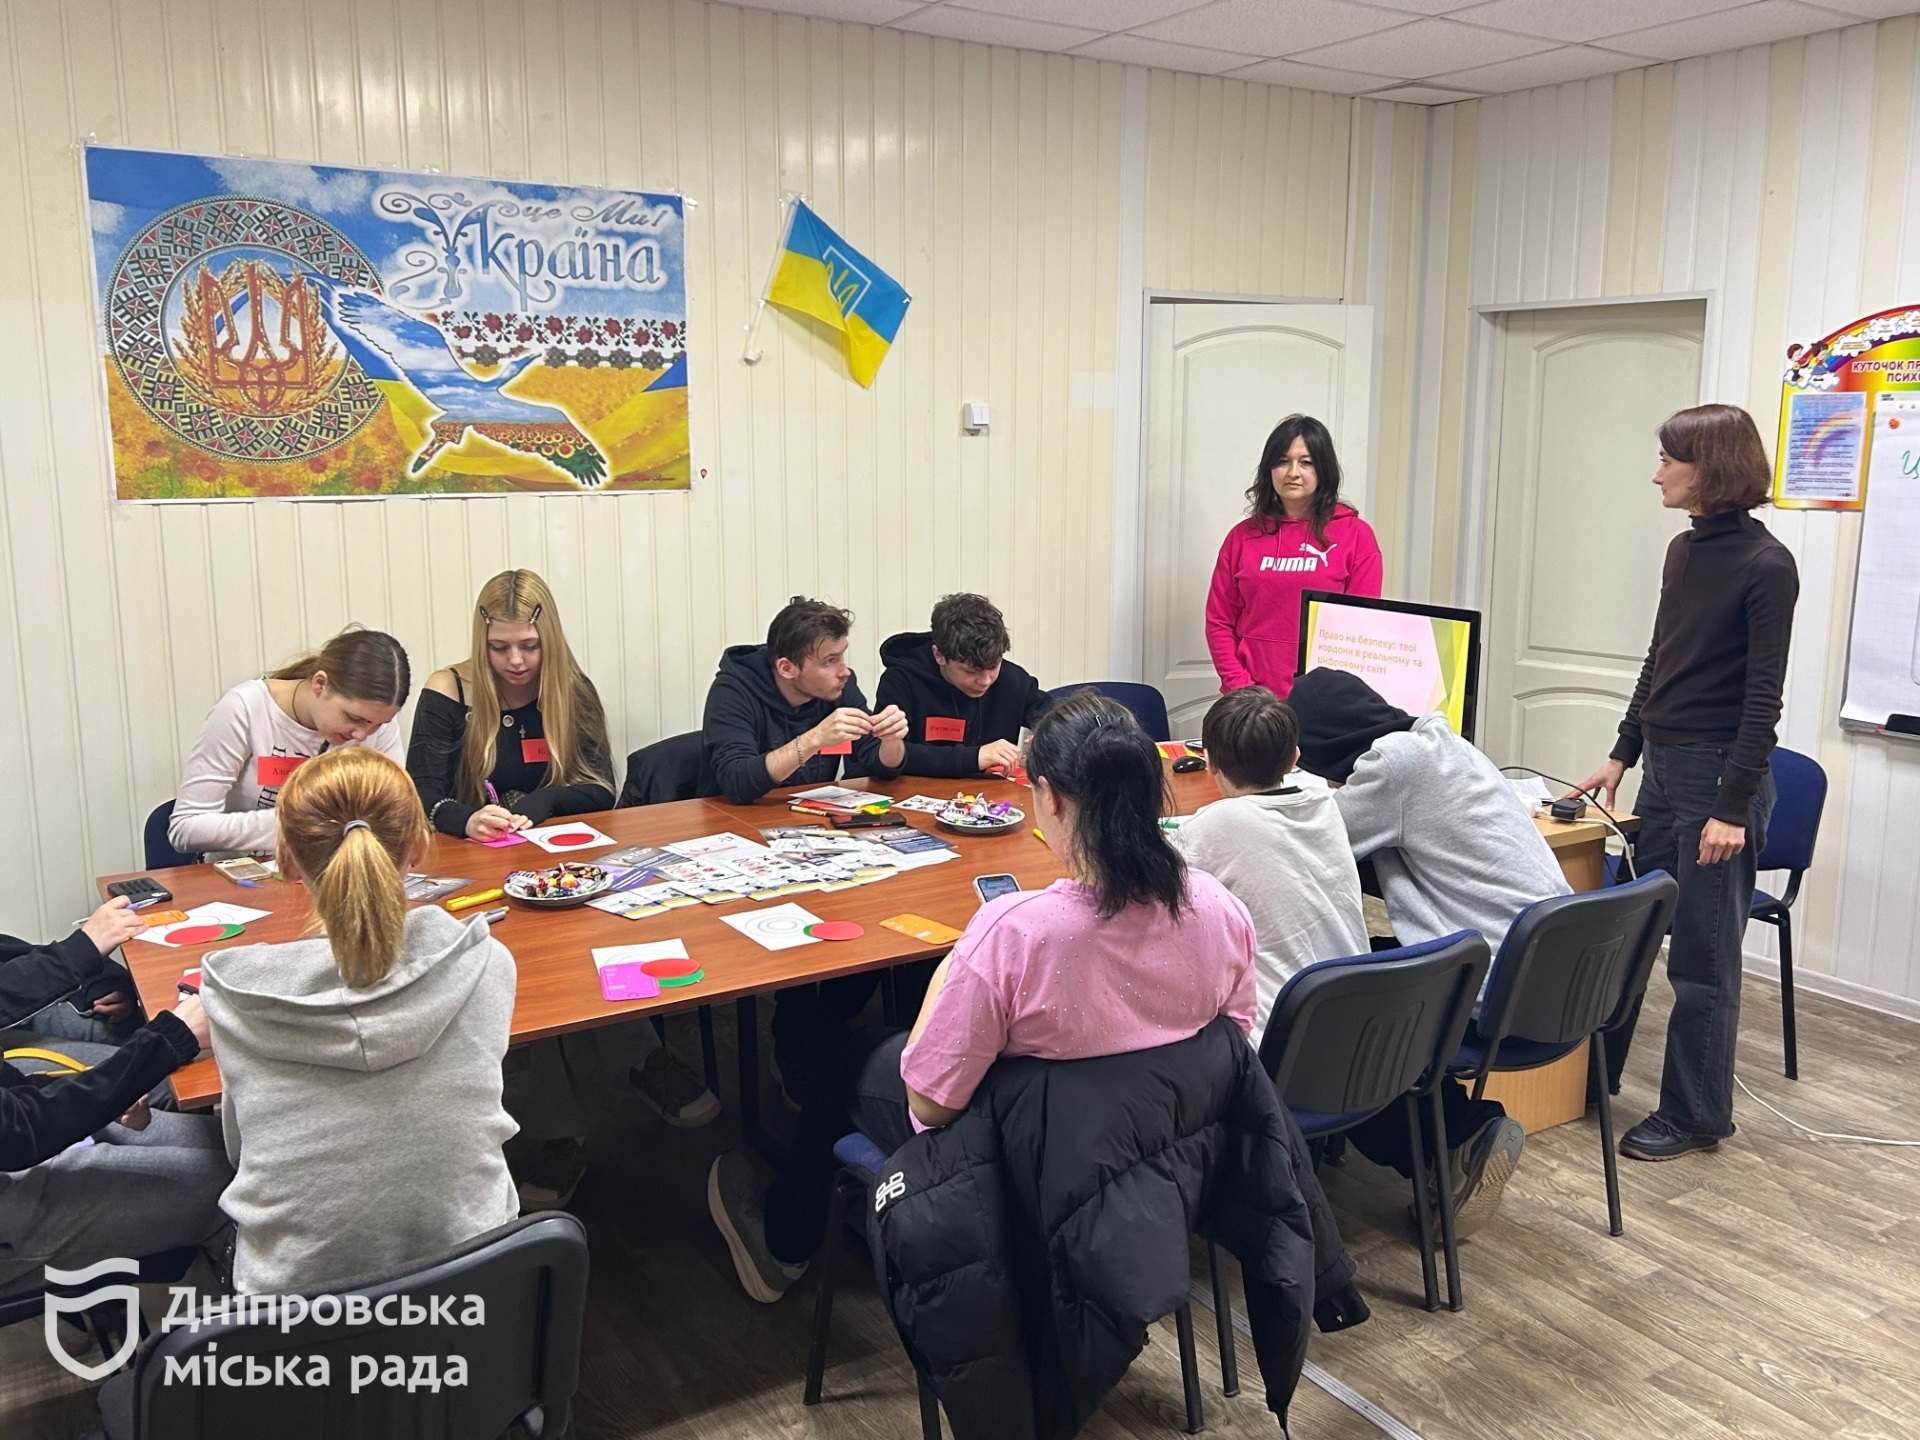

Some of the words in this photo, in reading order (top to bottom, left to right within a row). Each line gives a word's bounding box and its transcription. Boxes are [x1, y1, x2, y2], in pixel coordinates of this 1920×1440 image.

[1853, 360, 1905, 372] КУТОЧОК
[1260, 556, 1318, 572] PUMA
[1319, 629, 1344, 641] Право
[1346, 635, 1356, 643] на
[1358, 635, 1396, 651] безпеку:
[1399, 643, 1417, 653] твої
[1317, 656, 1365, 673] цифровому
[1367, 664, 1387, 675] світі
[1318, 644, 1353, 656] кордони
[1362, 650, 1411, 667] реальному
[1412, 659, 1422, 668] та
